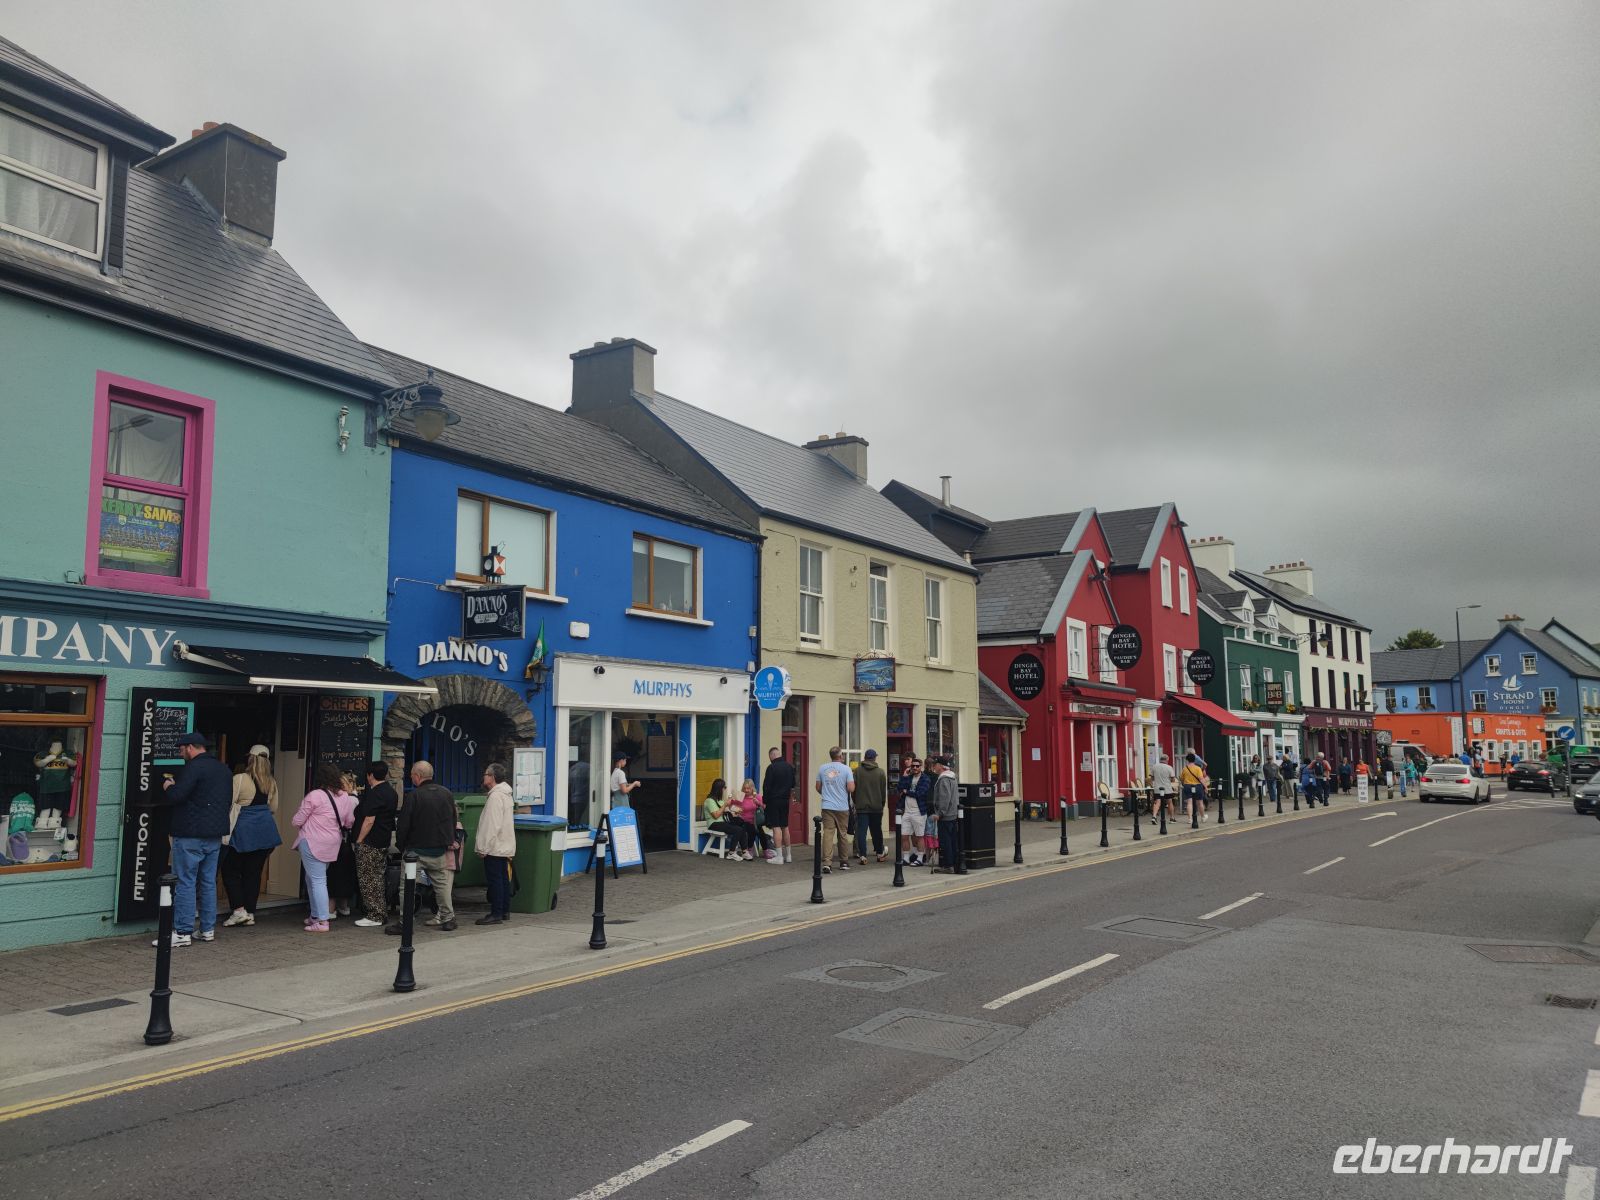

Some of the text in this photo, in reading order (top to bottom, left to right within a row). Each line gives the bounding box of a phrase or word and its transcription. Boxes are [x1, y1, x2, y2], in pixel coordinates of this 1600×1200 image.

[418, 640, 508, 672] DANNO'S
[633, 679, 692, 698] MURPHYS
[1493, 691, 1534, 701] STRAND
[140, 699, 154, 791] CRÊPES
[134, 813, 149, 901] COFFEE
